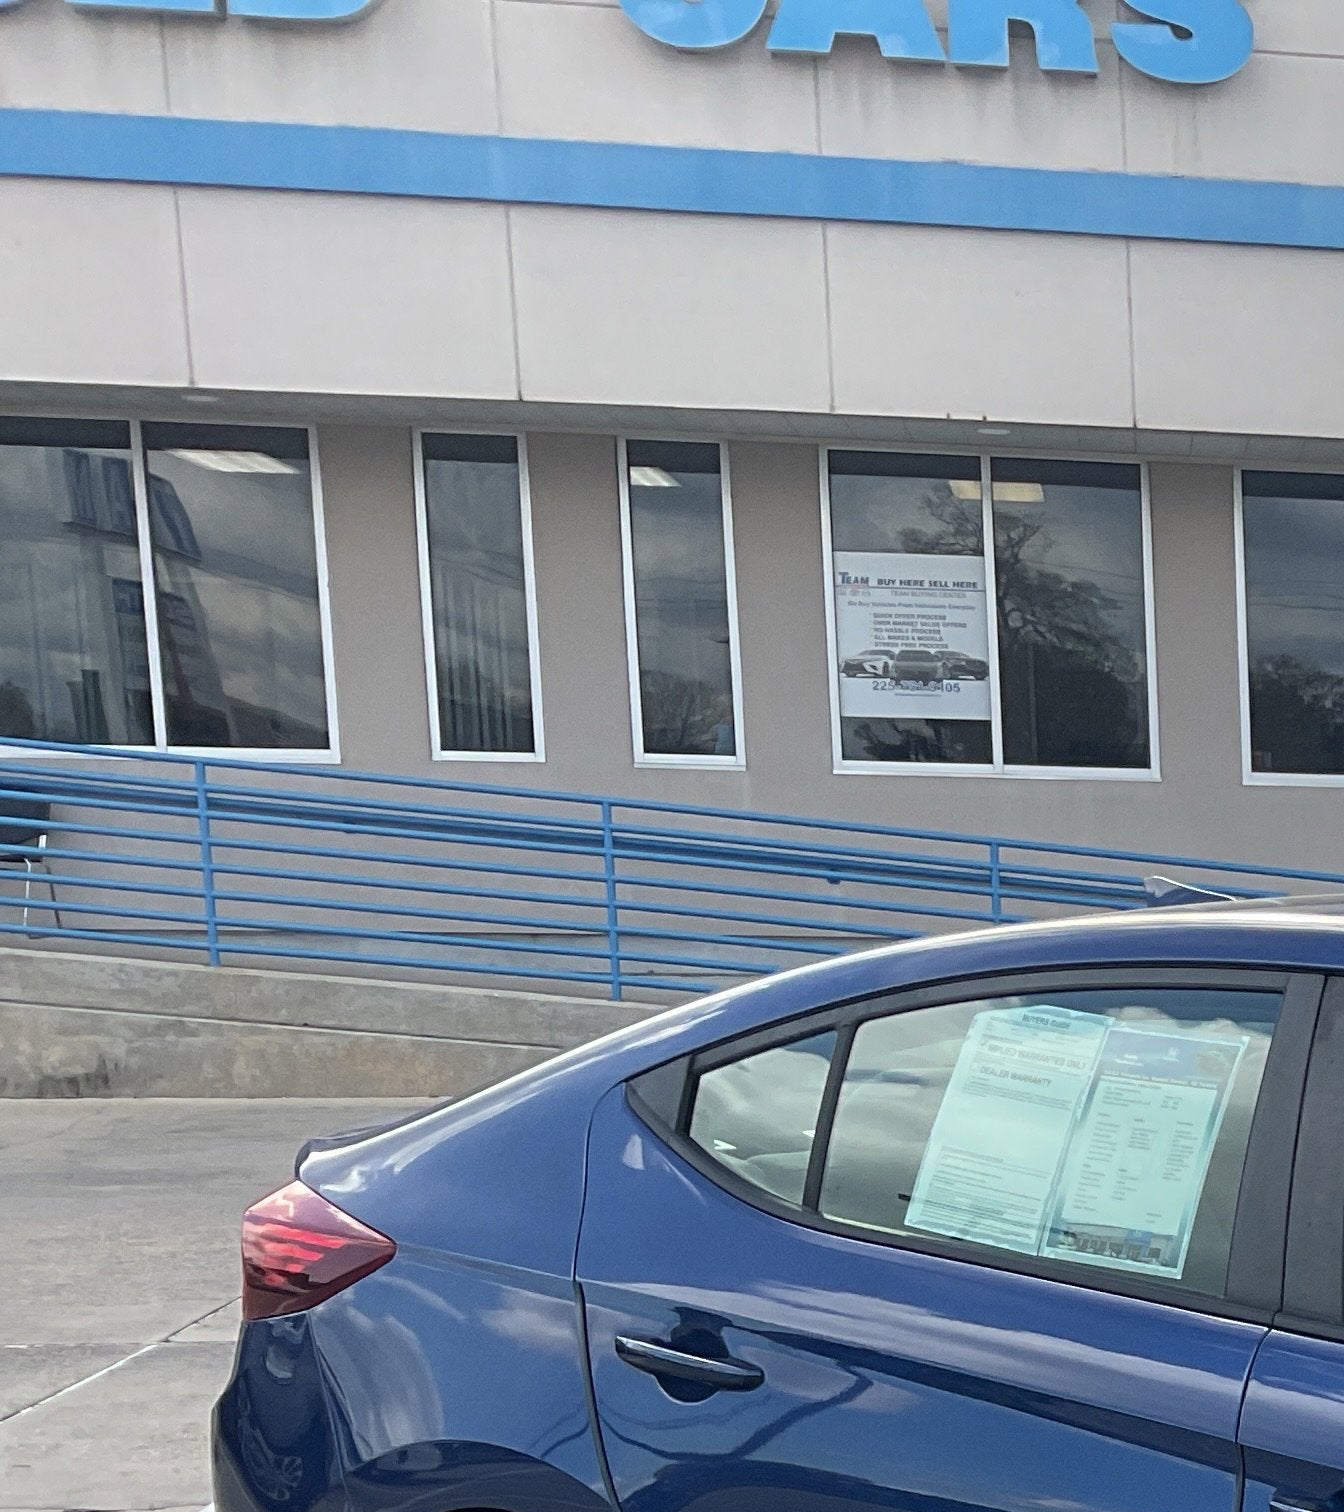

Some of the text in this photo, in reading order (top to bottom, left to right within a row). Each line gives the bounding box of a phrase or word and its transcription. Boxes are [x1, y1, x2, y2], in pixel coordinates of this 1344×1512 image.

[877, 578, 896, 586] BUY
[899, 579, 925, 587] HERE
[928, 580, 949, 588] SELL
[952, 581, 978, 589] HERE
[1022, 1014, 1049, 1026] BUYERS
[980, 1065, 1010, 1079] DEALER
